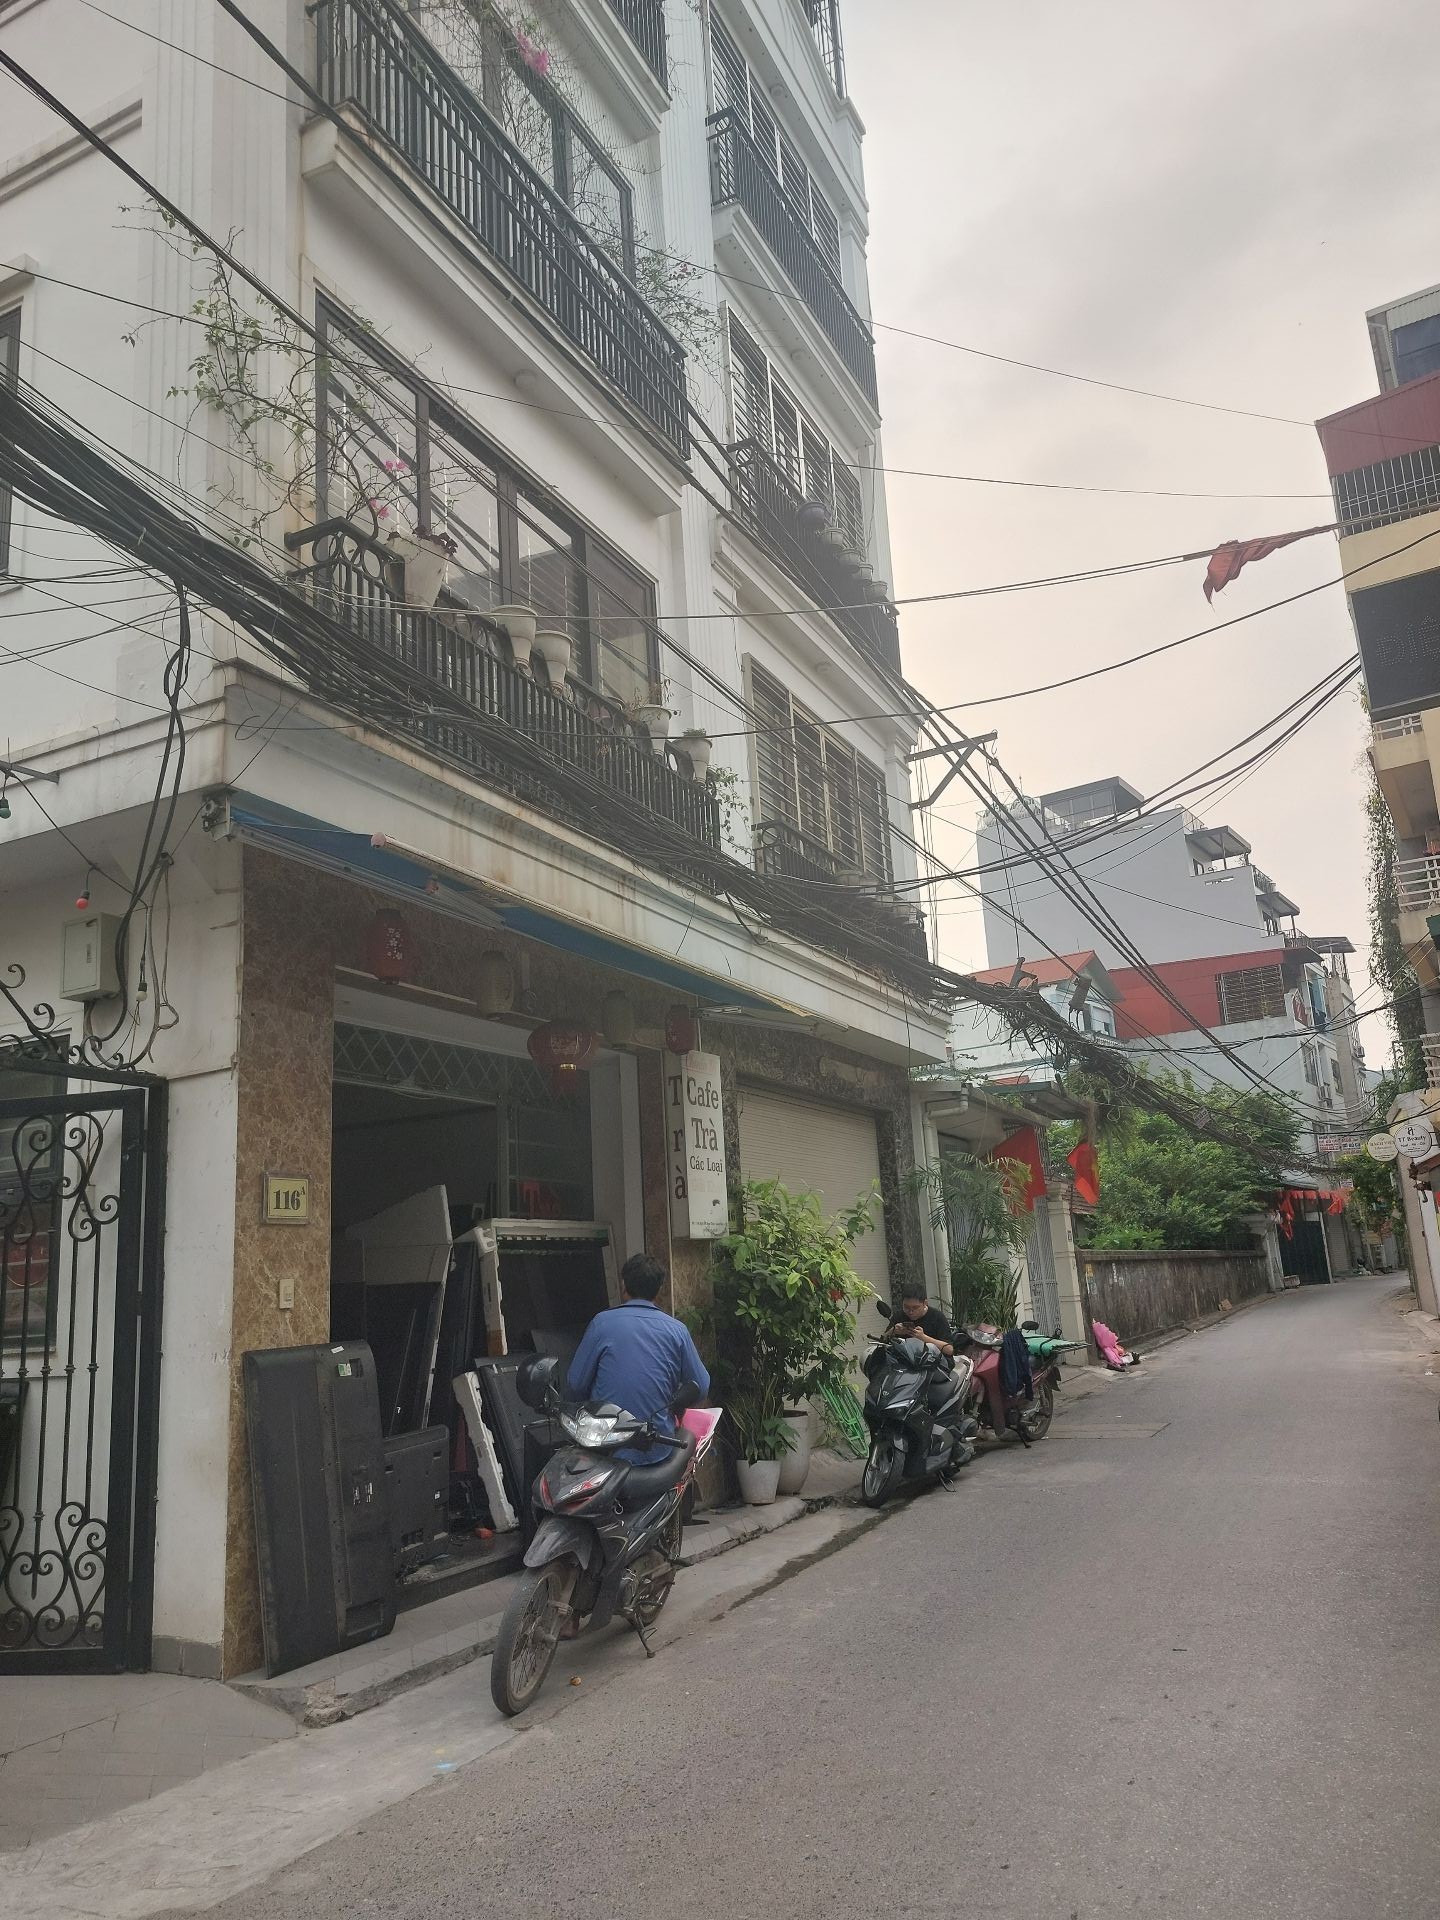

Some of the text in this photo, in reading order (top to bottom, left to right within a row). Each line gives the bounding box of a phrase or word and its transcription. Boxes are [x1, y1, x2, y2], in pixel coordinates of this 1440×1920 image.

[687, 1076, 719, 1110] Cafe
[691, 1116, 719, 1152] Trà
[690, 1155, 724, 1176] Các Loại
